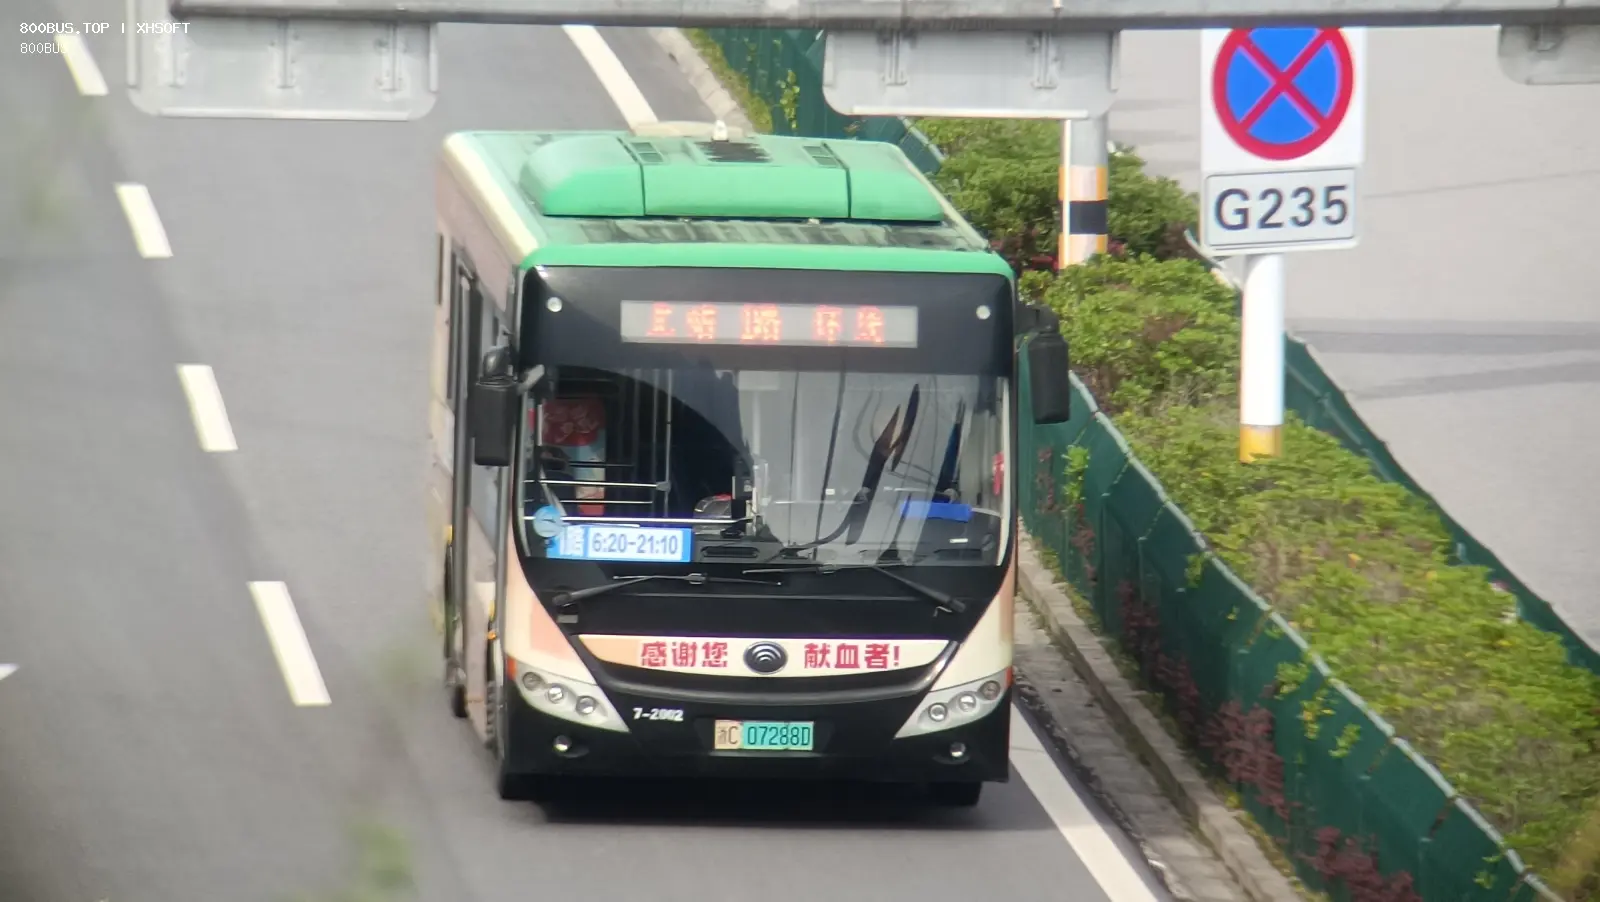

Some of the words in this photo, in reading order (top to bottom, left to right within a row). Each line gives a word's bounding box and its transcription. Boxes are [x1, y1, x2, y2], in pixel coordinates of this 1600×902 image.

[1214, 185, 1348, 231] G235
[592, 532, 678, 554] 6:20-21:10
[641, 641, 728, 668] 感谢您
[804, 643, 900, 669] 献血者!
[747, 726, 811, 746] 07288D
